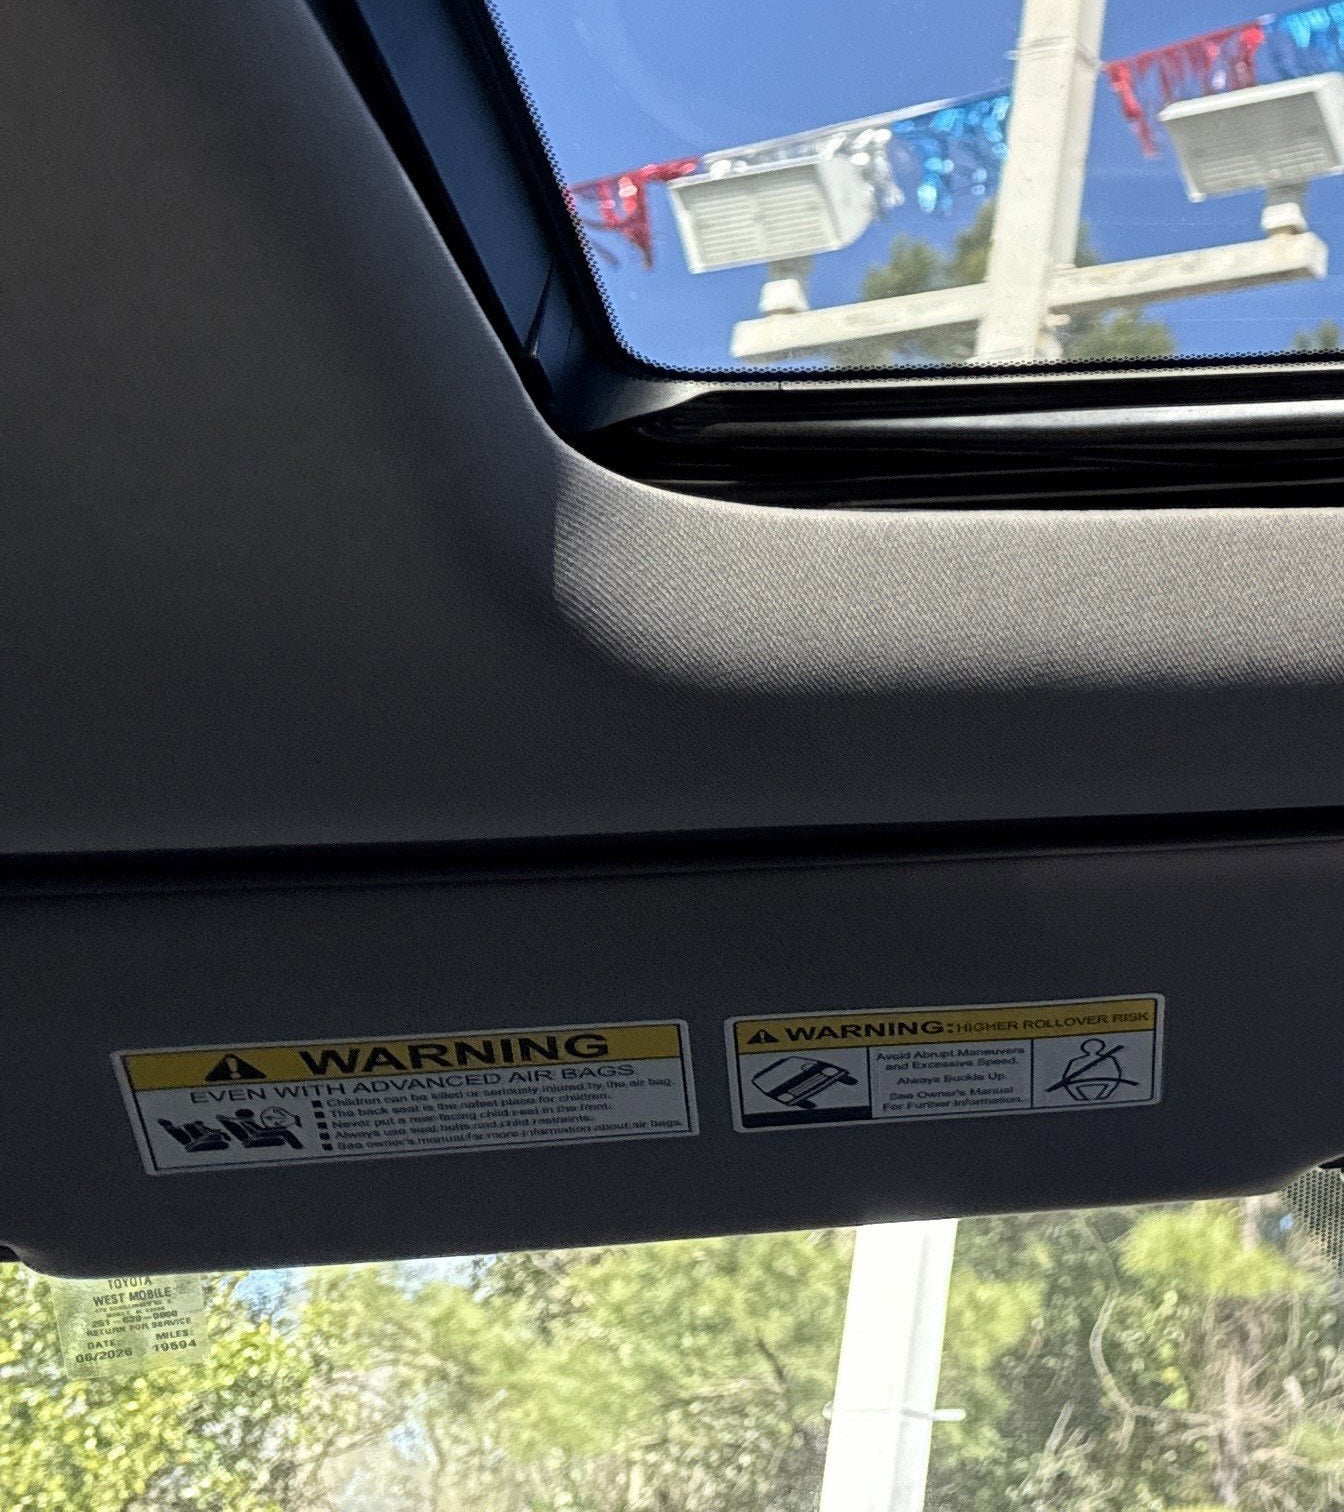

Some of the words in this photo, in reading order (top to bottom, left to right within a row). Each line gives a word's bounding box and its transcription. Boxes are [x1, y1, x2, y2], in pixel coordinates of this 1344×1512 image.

[785, 1020, 954, 1041] WARNING:
[957, 1021, 1019, 1034] HIGHER
[1023, 1014, 1108, 1029] ROLLOVER
[1112, 1011, 1149, 1022] RISK
[299, 1034, 609, 1075] WARNING
[190, 1088, 266, 1104] EVEN
[273, 1081, 347, 1098] WITH
[351, 1072, 502, 1095] ADVANCED
[509, 1068, 552, 1083] AIR
[562, 1064, 635, 1080] BAGS
[108, 1276, 153, 1290] TOYOTA
[92, 1293, 125, 1306] WEST
[128, 1287, 172, 1302] MOBILE
[85, 1326, 126, 1337] RETURN
[151, 1317, 192, 1329] SERVICE
